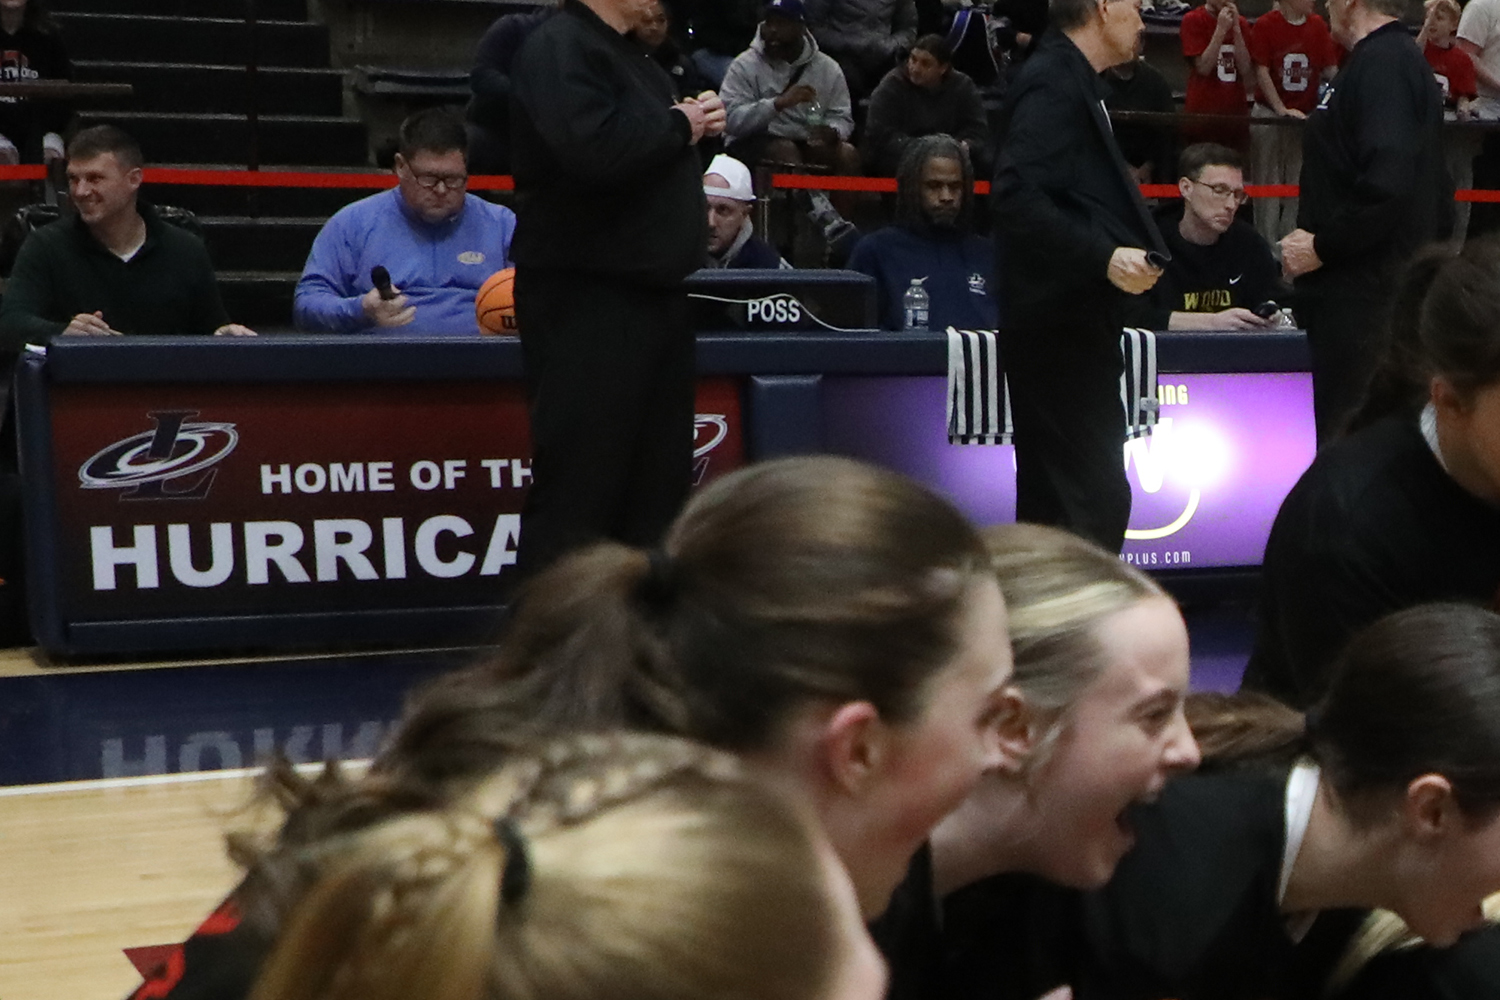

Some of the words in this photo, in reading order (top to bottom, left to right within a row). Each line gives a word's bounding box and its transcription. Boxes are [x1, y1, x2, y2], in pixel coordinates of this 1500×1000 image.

[747, 299, 801, 323] POSS
[260, 461, 395, 495] HOME
[409, 459, 467, 491] OF
[481, 457, 534, 489] TH
[90, 513, 522, 591] HURRICA
